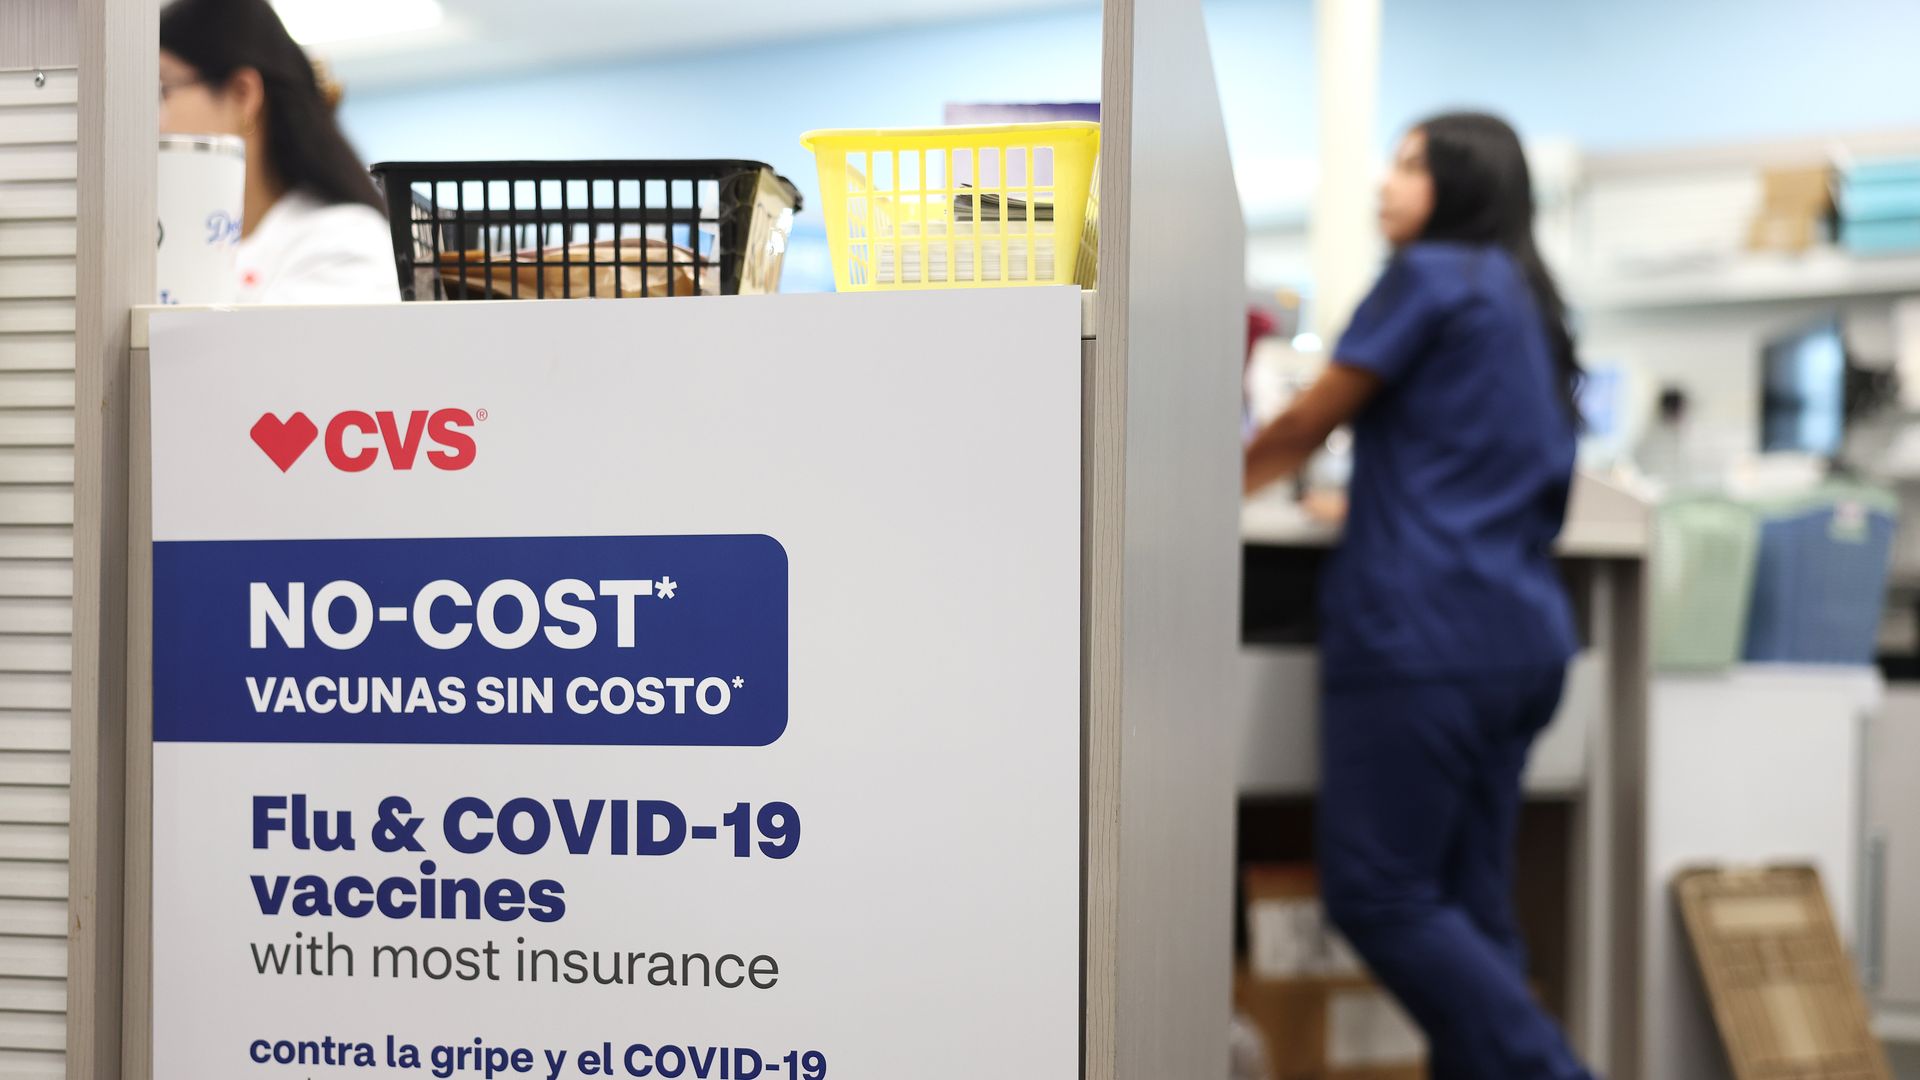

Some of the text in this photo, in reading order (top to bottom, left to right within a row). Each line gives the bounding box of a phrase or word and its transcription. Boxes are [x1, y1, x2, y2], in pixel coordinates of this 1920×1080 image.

[245, 676, 467, 714] VACUNAS
[476, 676, 553, 714] SIN
[250, 794, 801, 860] Flu & COVID-19
[249, 859, 567, 923] vaccines
[250, 931, 779, 990] with most insurance
[249, 1034, 828, 1080] contra la gripe y el COVID-19
